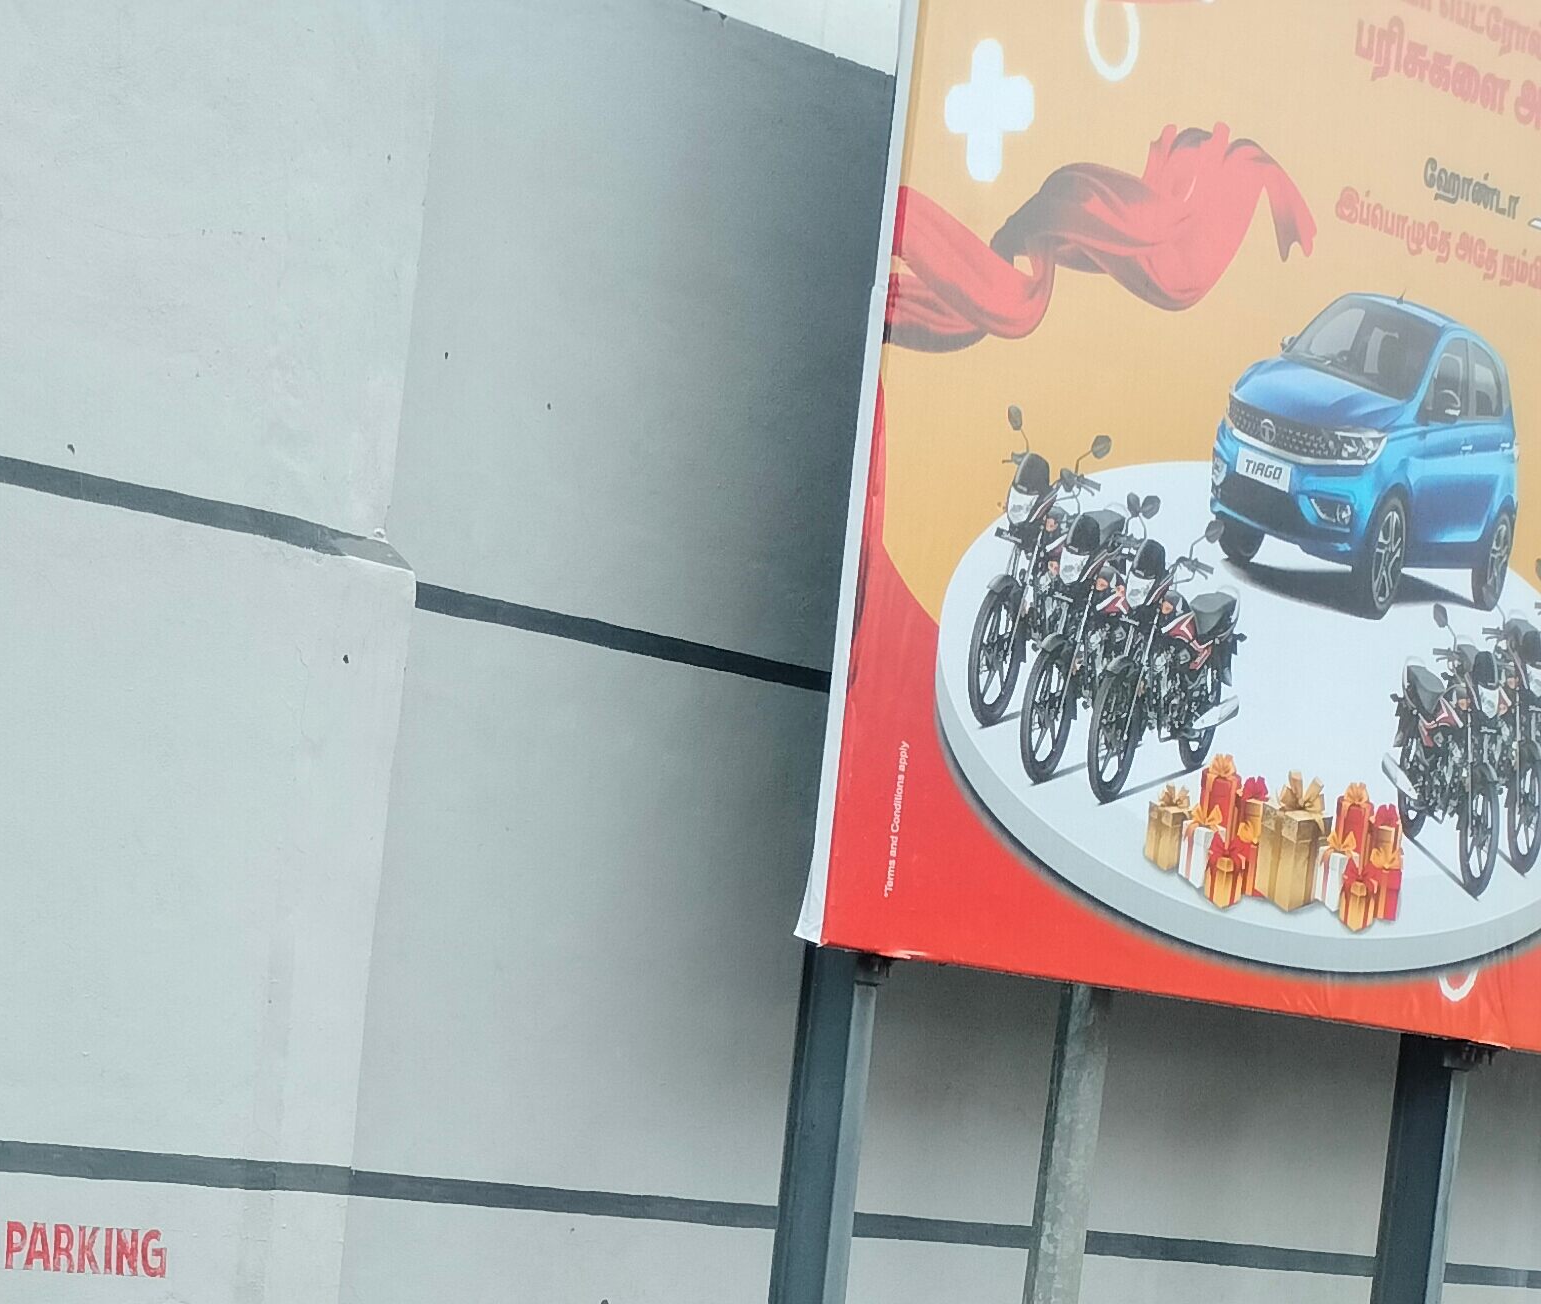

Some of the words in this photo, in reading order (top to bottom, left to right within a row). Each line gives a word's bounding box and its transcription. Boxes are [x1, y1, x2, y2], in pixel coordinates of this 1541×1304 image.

[1245, 458, 1283, 481] TIAGO
[899, 740, 910, 772] apply
[891, 774, 905, 833] Conditions
[889, 835, 898, 858] and
[5, 1221, 167, 1279] PARKING
